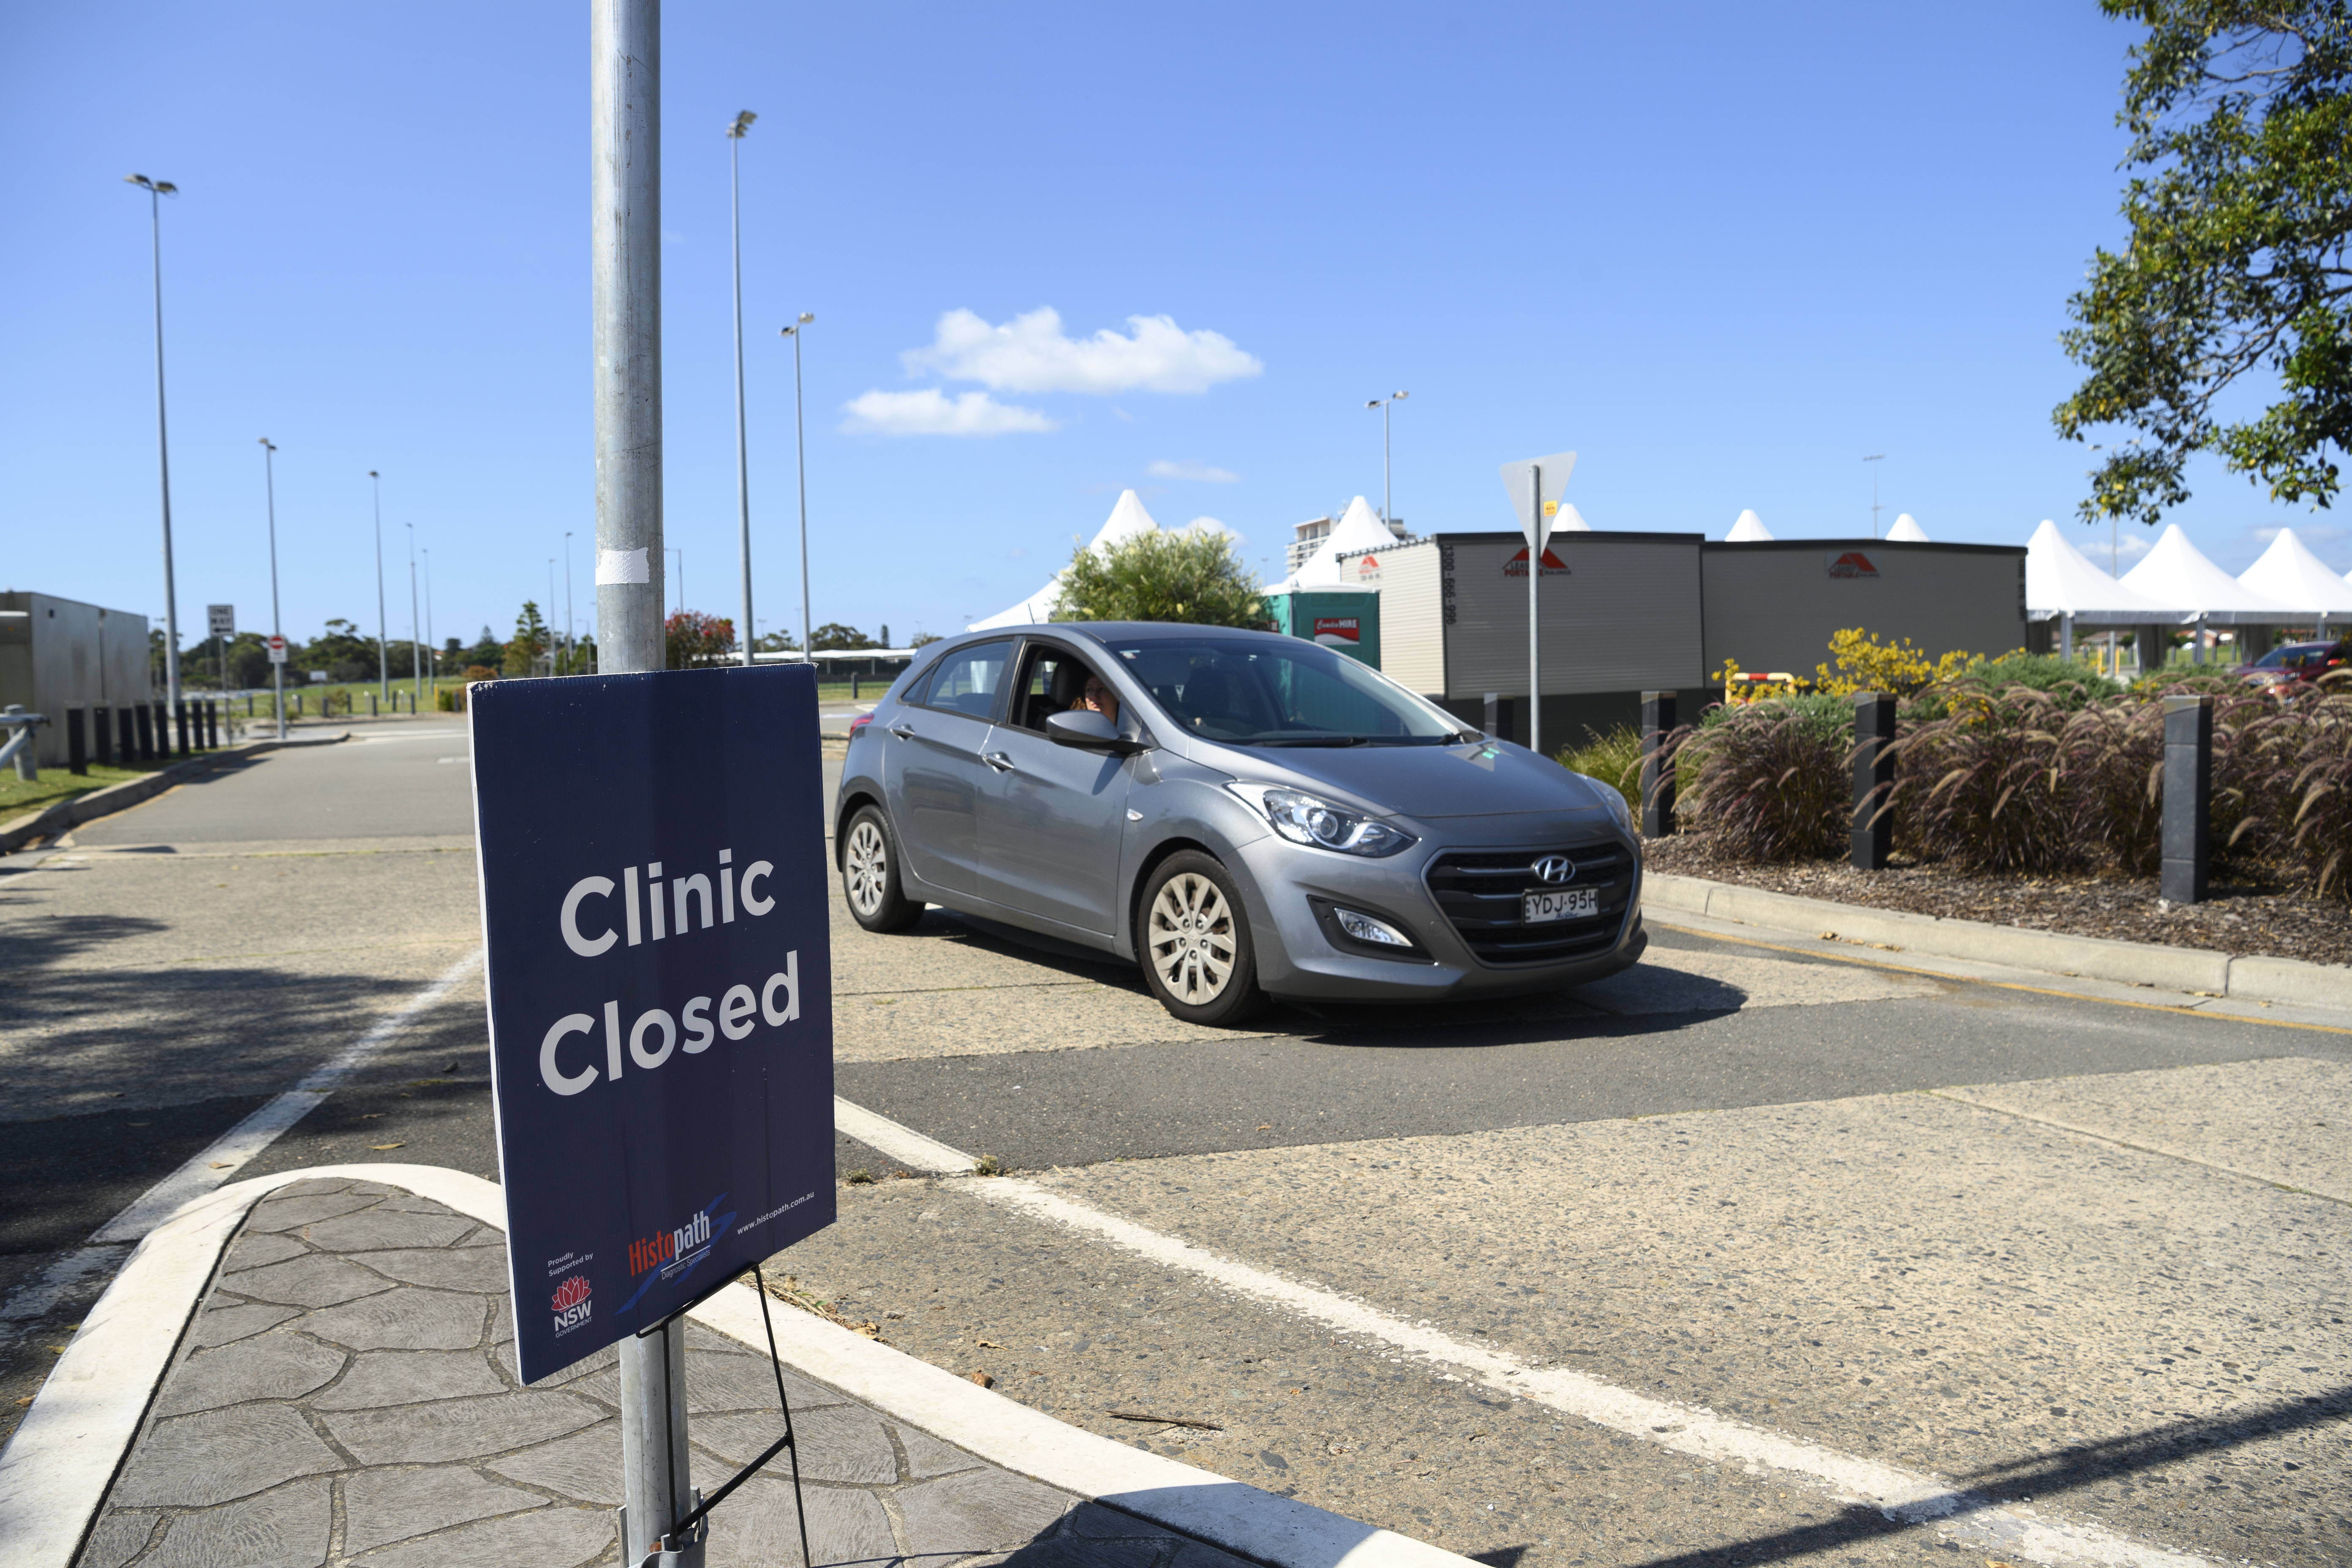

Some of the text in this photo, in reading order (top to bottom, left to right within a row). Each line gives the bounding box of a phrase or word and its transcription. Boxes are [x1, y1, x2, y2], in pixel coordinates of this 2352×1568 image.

[1504, 569, 1543, 577] PORTAE
[1339, 619, 1357, 629] HIRE
[560, 848, 776, 957] Clinic
[539, 950, 800, 1096] Closed
[737, 1191, 814, 1235] www.histopath.com.au
[628, 1210, 710, 1277] Histopath
[548, 1252, 574, 1267] Proudly
[549, 1253, 593, 1277] Supported by
[662, 1249, 710, 1280] Diagnostic Specialists
[554, 1300, 591, 1331] NSW
[555, 1316, 592, 1338] GOVERNMENT
